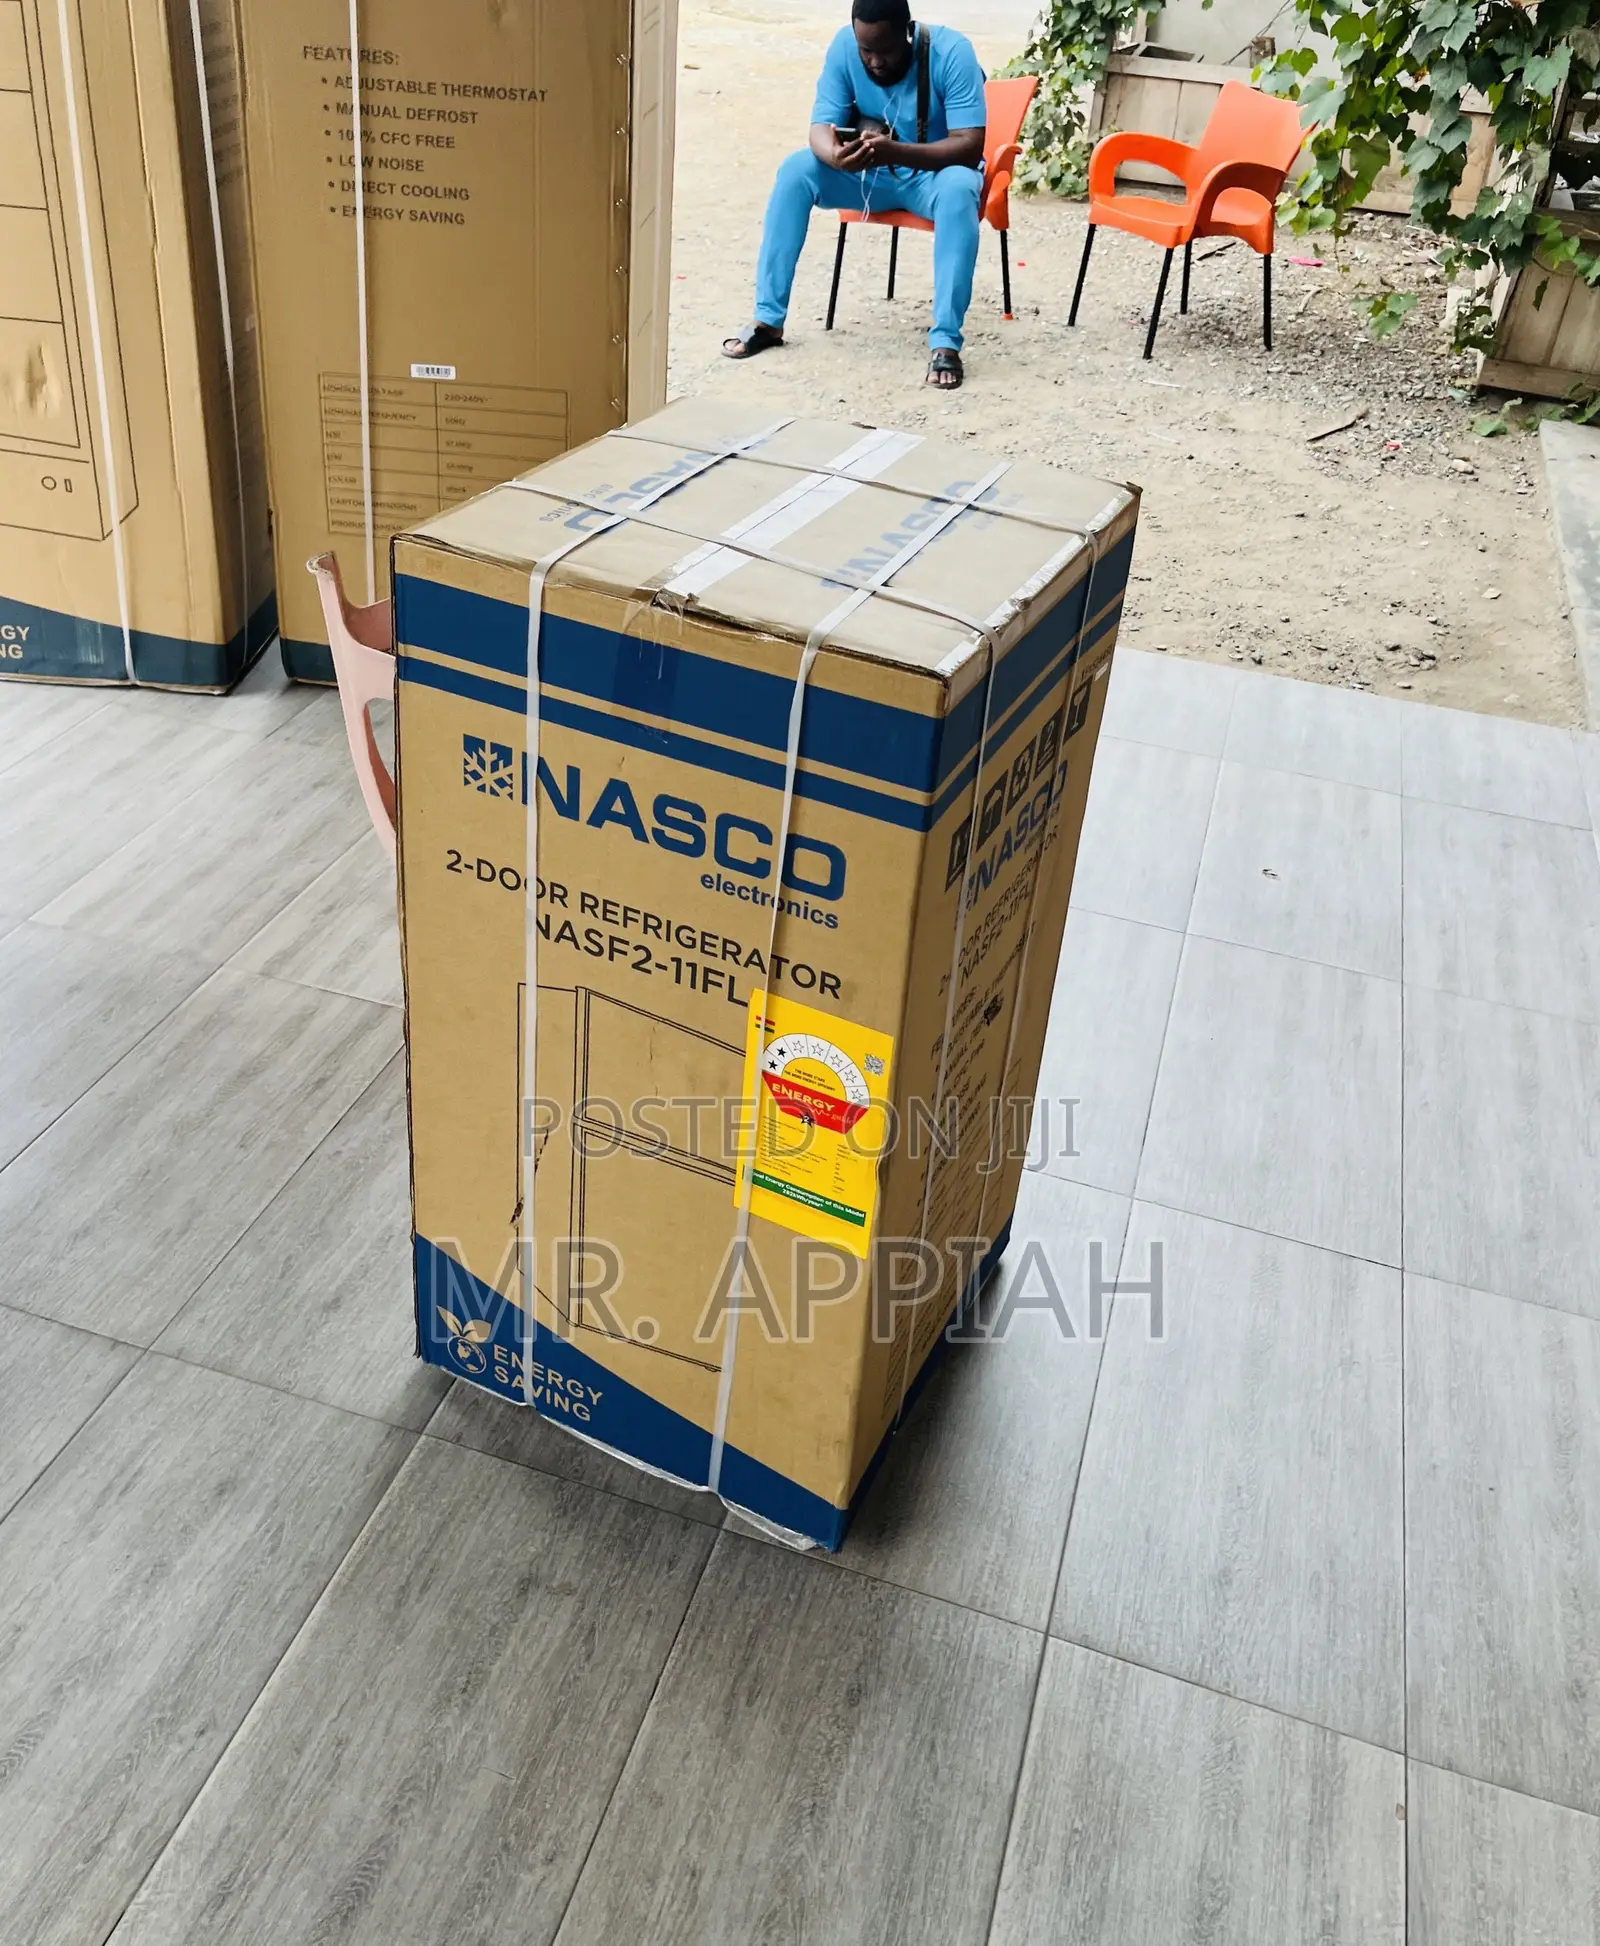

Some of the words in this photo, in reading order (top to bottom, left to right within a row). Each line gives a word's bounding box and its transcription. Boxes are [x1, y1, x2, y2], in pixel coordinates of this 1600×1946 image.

[442, 83, 548, 102] THERMOSTAT
[406, 107, 479, 124] DEFROST
[337, 128, 376, 144] 10%
[381, 132, 411, 146] CFC
[416, 134, 455, 149] FREE
[379, 157, 424, 172] NOISE
[401, 184, 470, 201] COOLING
[409, 209, 465, 225] SAVING
[522, 751, 848, 902] NASCO
[700, 870, 840, 930] electronics
[446, 849, 569, 908] 2-DOOR
[580, 891, 842, 1000] REFRIGERATOR
[535, 913, 749, 1008] NASF2-11FL
[772, 1083, 836, 1112] ENERGY
[493, 1343, 603, 1406] ENERGY
[494, 1366, 591, 1422] SAVING
